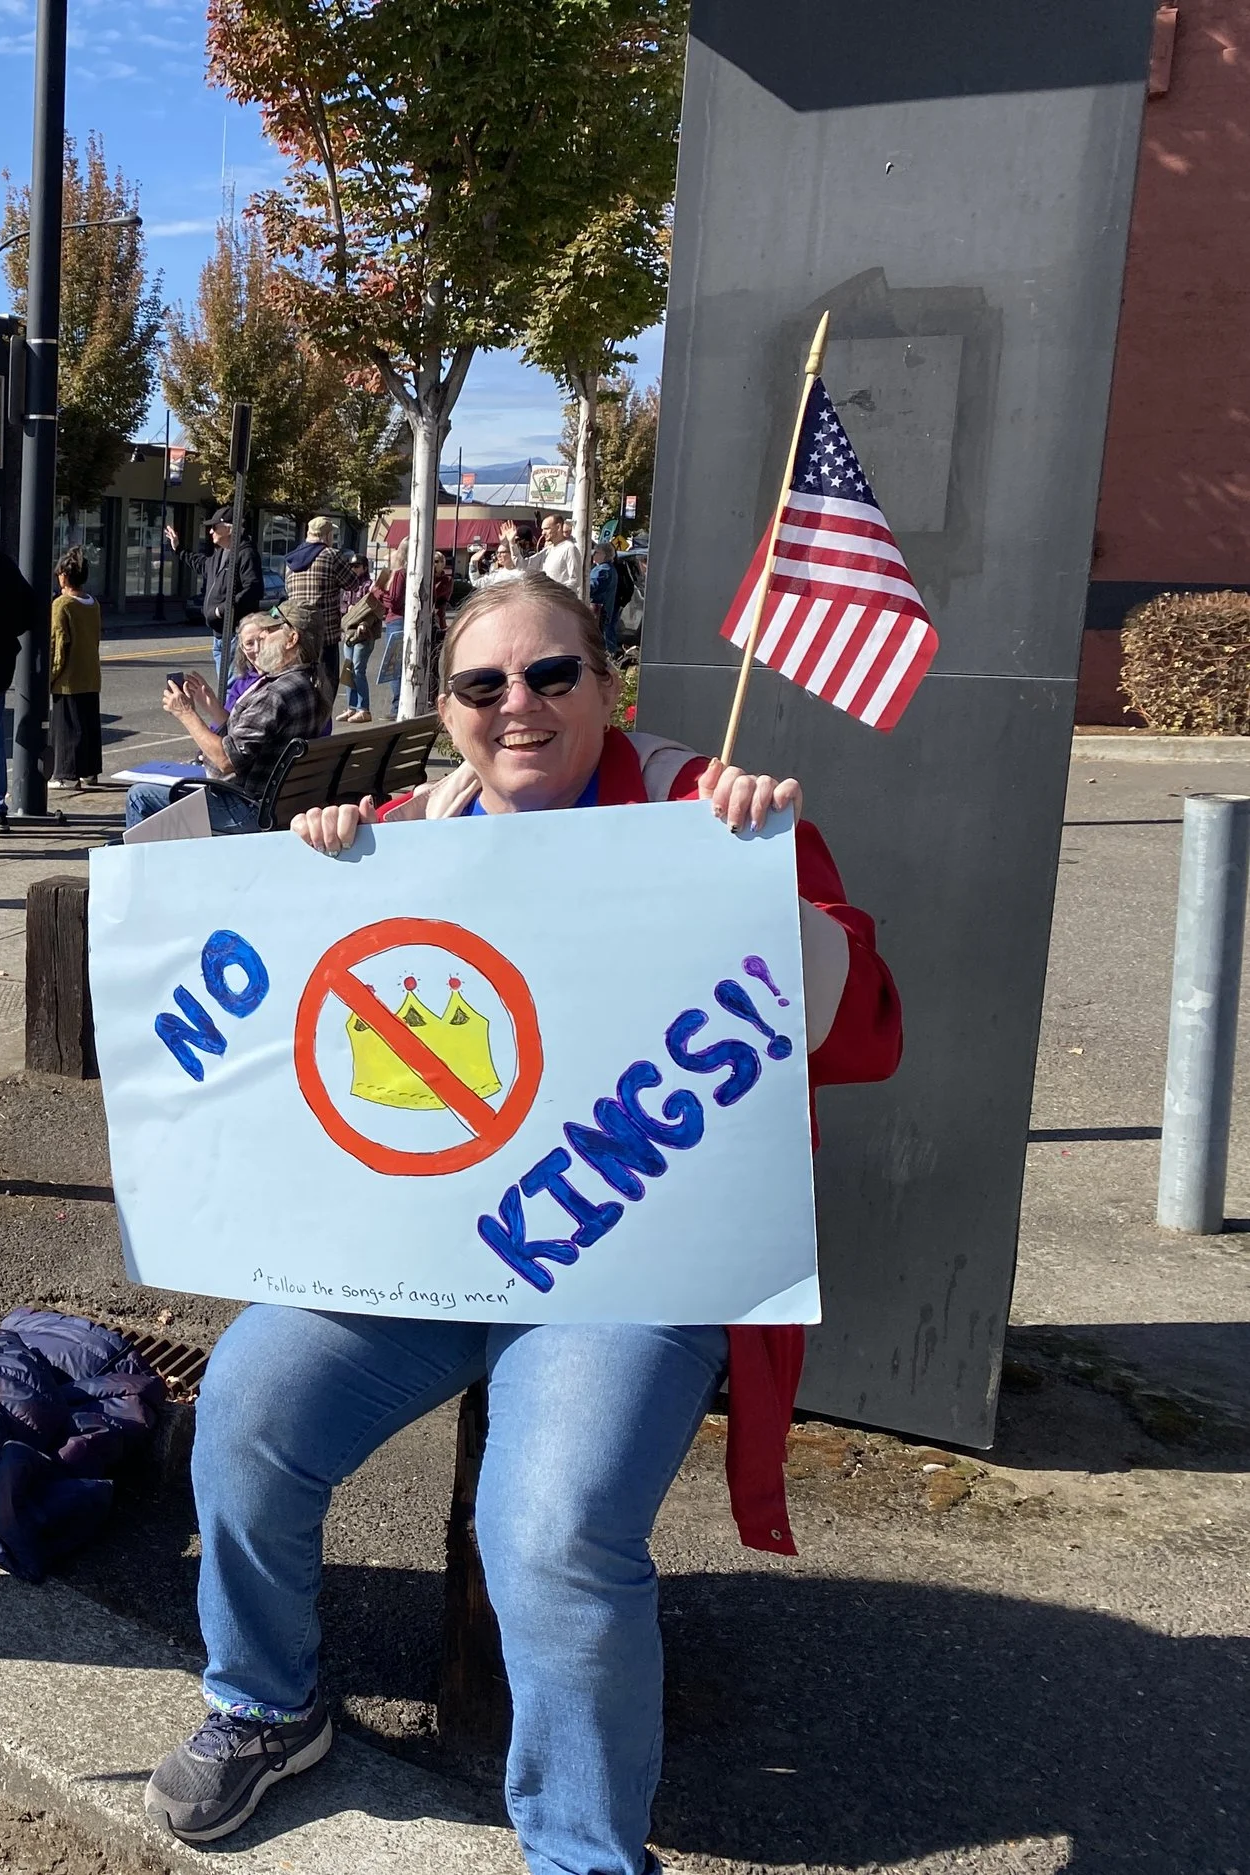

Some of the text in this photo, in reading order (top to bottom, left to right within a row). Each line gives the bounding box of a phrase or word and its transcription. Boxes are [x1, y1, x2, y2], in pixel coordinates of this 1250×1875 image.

[154, 928, 271, 1083] NO
[476, 953, 795, 1294] KINGS!!
[266, 1275, 307, 1294] Follow
[312, 1280, 335, 1297] the
[389, 1281, 405, 1301] of
[408, 1290, 457, 1310] angry
[464, 1292, 509, 1305] men
